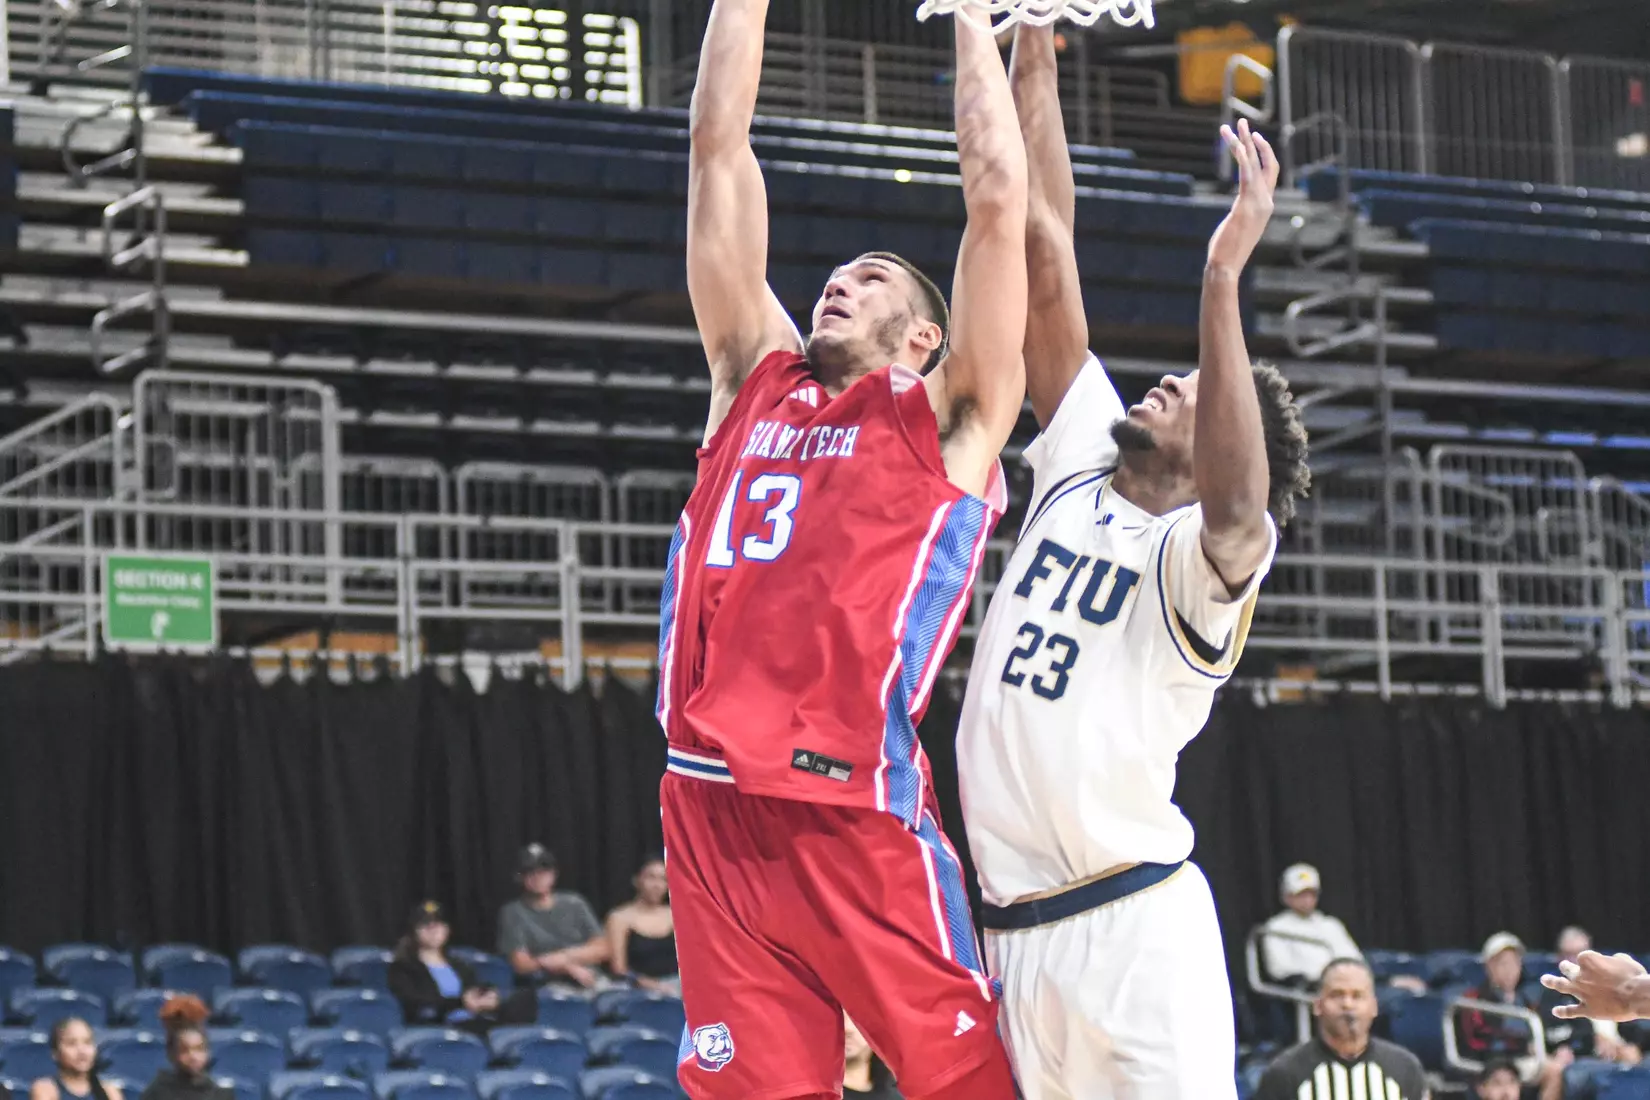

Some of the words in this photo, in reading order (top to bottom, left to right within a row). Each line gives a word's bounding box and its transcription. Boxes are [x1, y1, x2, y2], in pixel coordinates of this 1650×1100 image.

[801, 425, 860, 460] TECH
[705, 470, 803, 567] 13
[1012, 538, 1141, 627] FIU
[1001, 621, 1080, 701] 23
